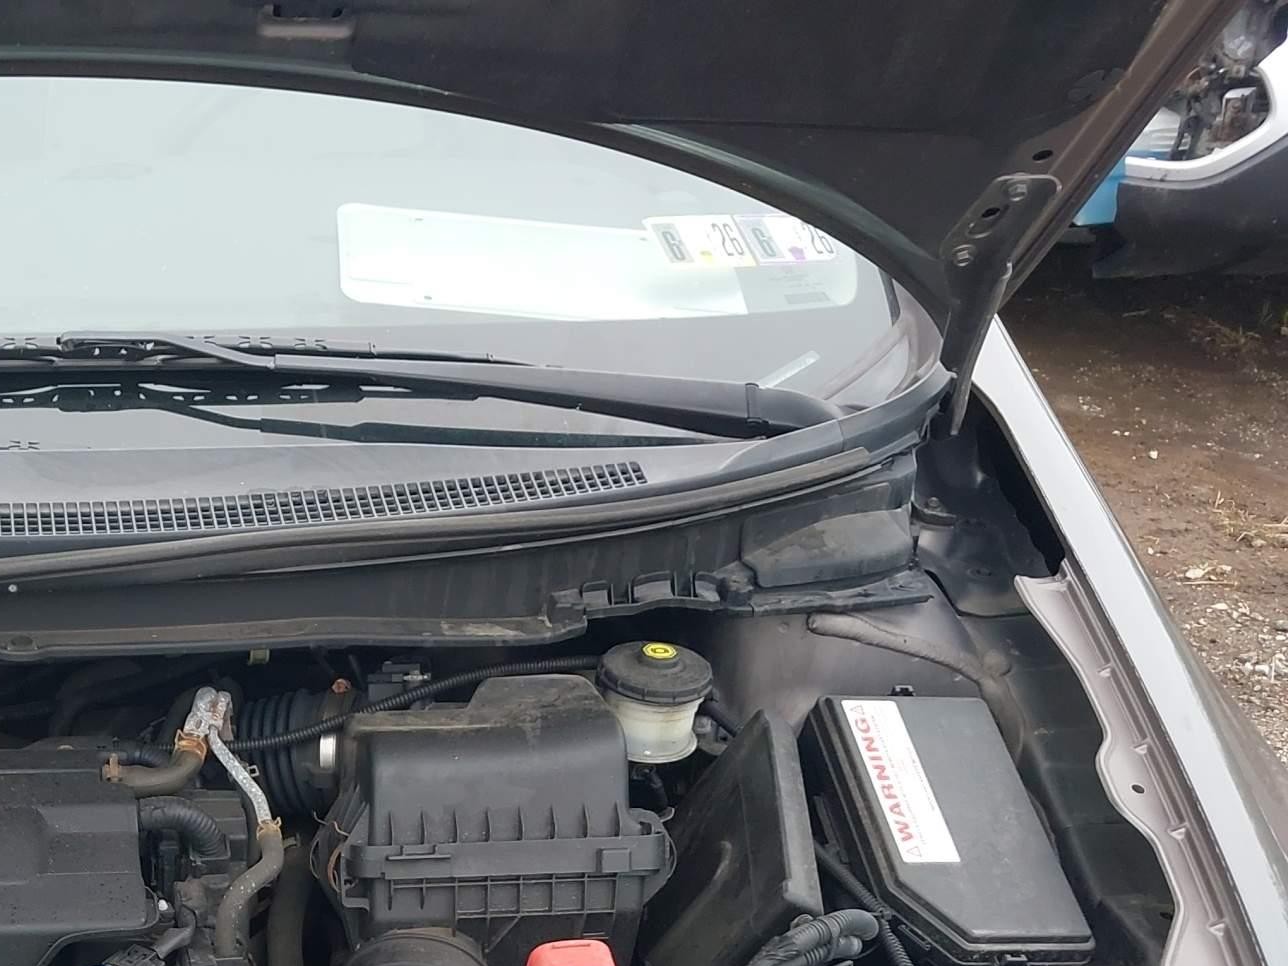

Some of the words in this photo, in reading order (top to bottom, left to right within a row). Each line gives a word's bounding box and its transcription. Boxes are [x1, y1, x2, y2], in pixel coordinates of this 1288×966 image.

[712, 223, 745, 256] 26
[751, 227, 777, 257] 6
[800, 222, 834, 254] 26
[855, 717, 914, 842] WARNING
